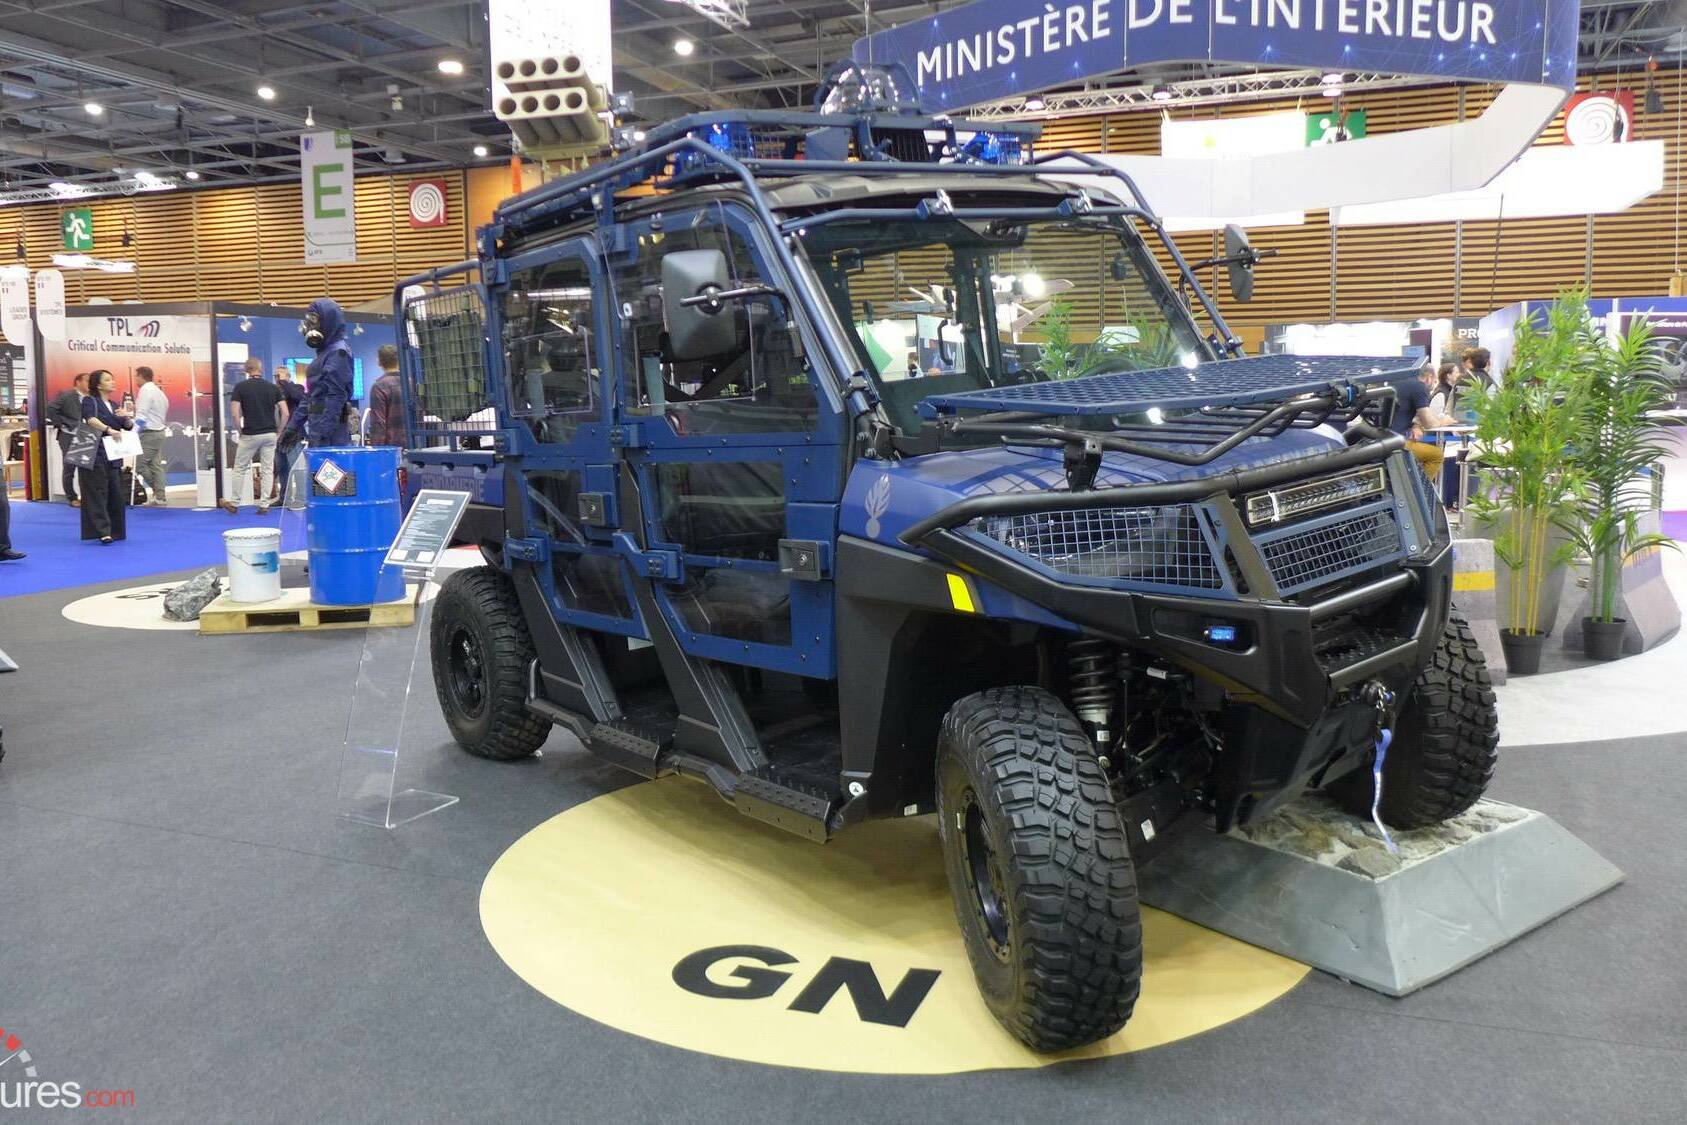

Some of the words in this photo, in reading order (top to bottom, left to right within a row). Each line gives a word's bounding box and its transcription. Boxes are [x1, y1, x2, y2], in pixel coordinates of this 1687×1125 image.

[917, 0, 1110, 86] MINISTÈRE
[1128, 0, 1193, 29] DE
[313, 163, 346, 219] E
[68, 339, 98, 351] Critical
[100, 341, 161, 353] Communication
[107, 317, 133, 336] TPL
[671, 944, 942, 1028] GN
